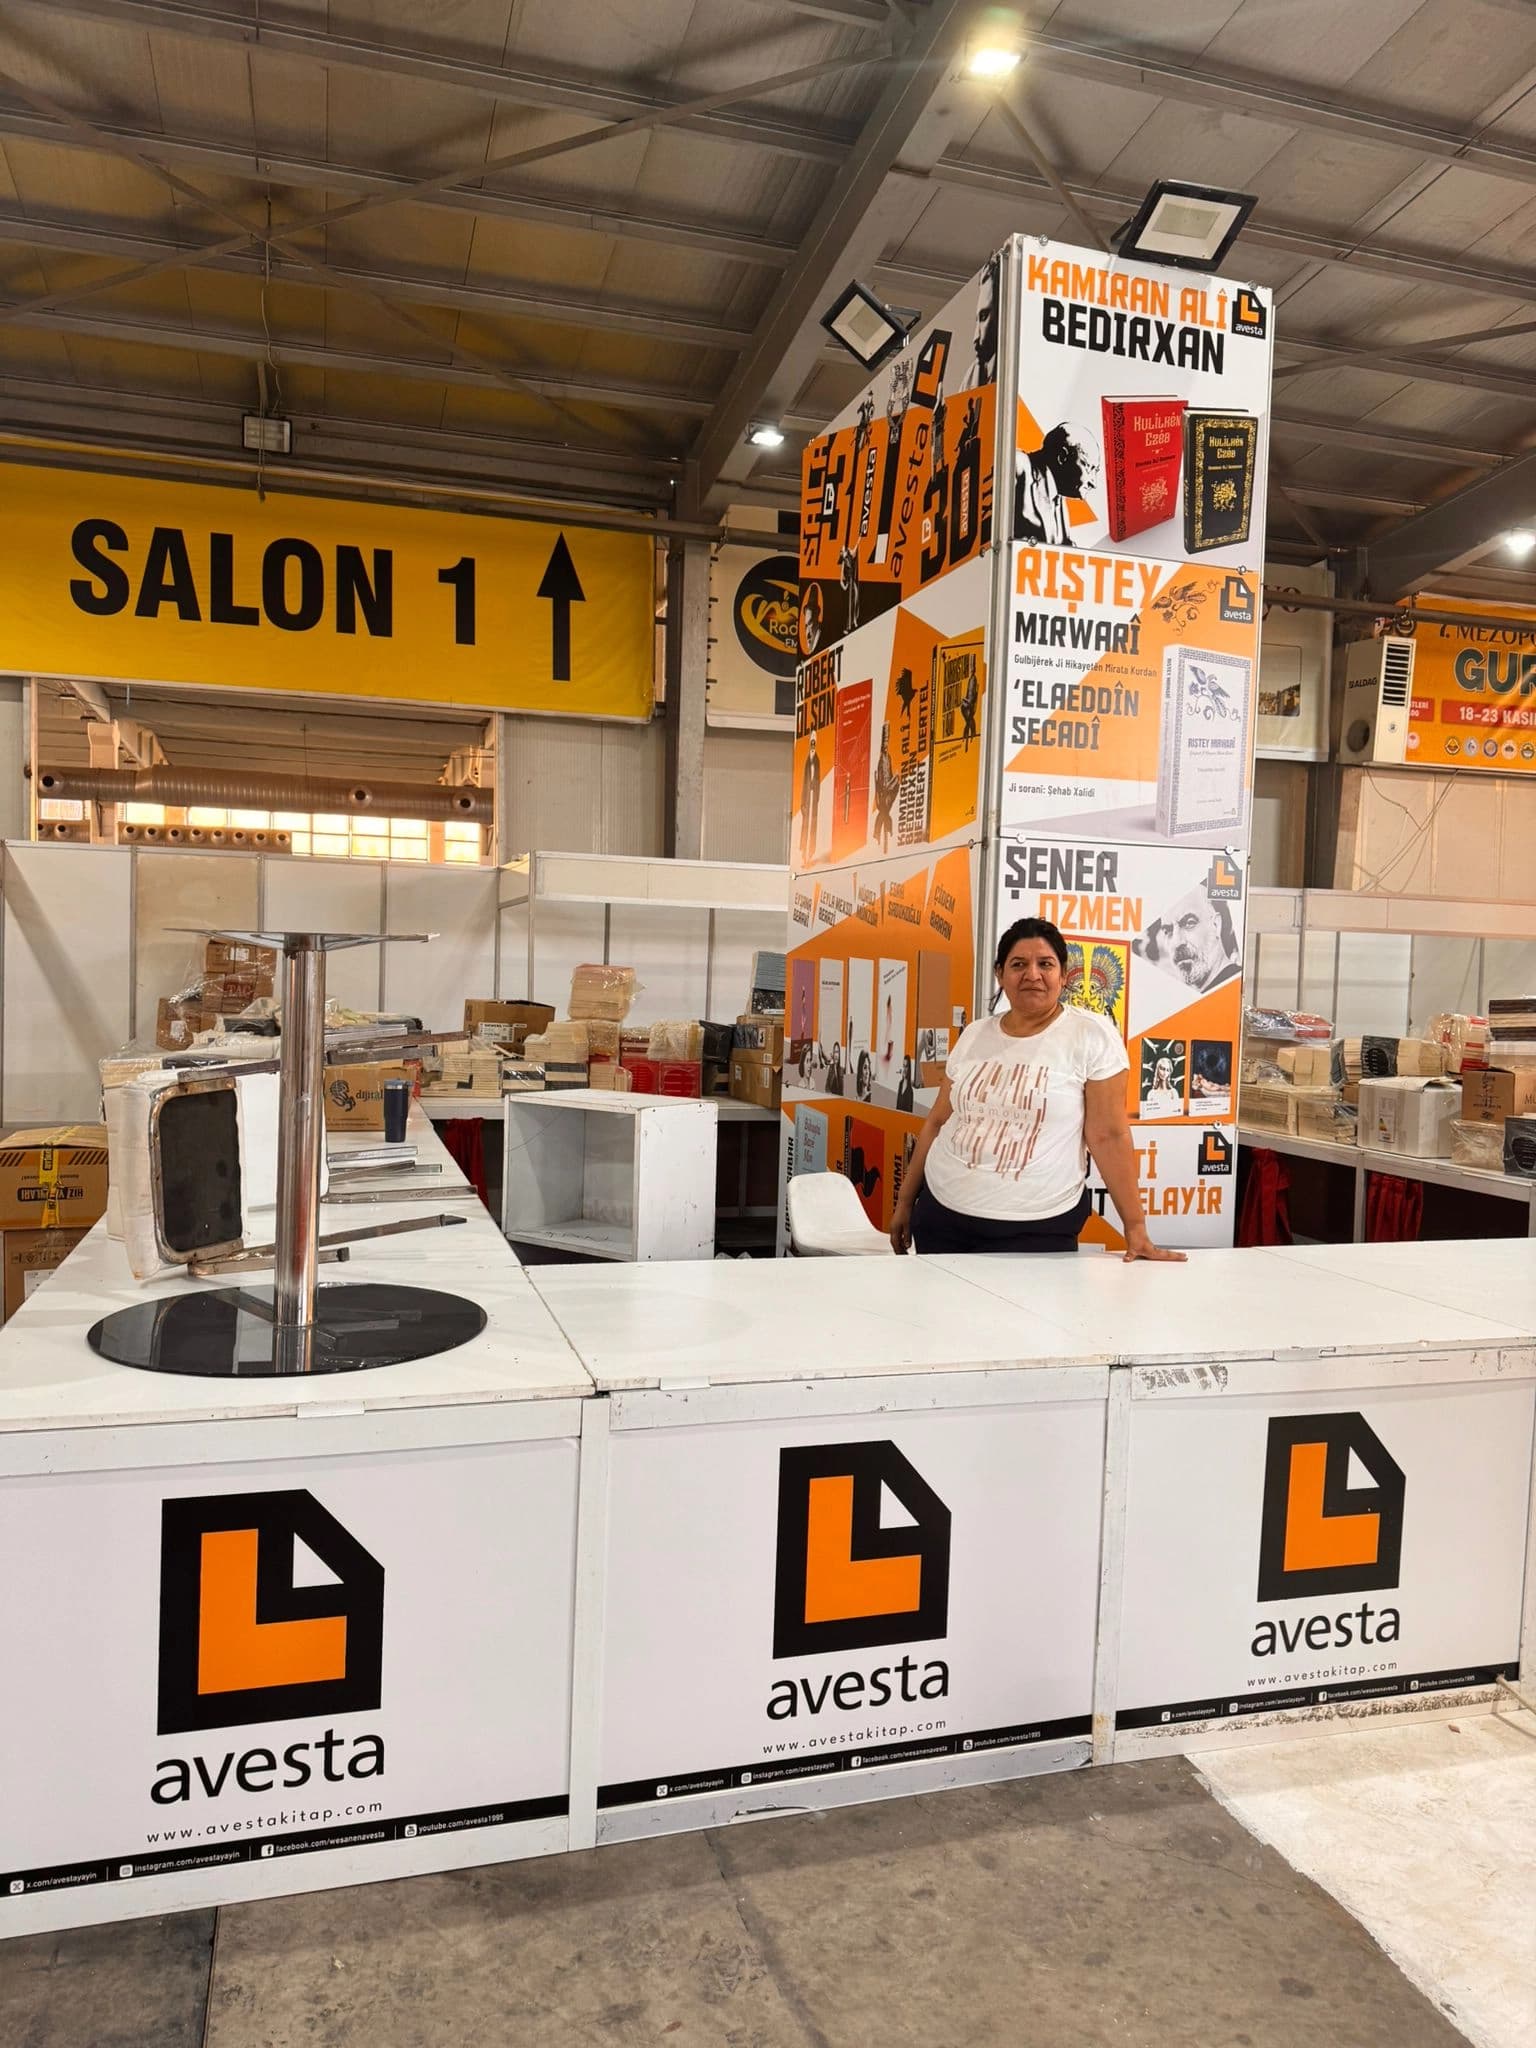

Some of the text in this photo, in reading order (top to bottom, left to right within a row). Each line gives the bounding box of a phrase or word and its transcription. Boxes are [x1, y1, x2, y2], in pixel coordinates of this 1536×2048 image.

[1028, 254, 1169, 318] KAMIRAN
[1043, 298, 1225, 374] BEDIRXAN
[1235, 323, 1264, 336] avesta
[860, 447, 877, 537] avesta
[891, 422, 929, 578] avesta
[960, 473, 969, 537] avesta
[70, 518, 476, 645] SALON 1
[1015, 611, 1141, 655] MIRWARÎ
[1223, 609, 1252, 621] avesta
[796, 646, 844, 704] ROBERT
[796, 688, 835, 739] OLSON
[1011, 715, 1101, 752] SECADÎ
[1459, 706, 1498, 723] 18-23
[1004, 846, 1118, 899] ŞENER
[1211, 887, 1239, 898] avesta
[1202, 1162, 1229, 1172] avesta
[1251, 1602, 1400, 1657] avesta
[766, 1655, 949, 1720] avesta
[763, 1719, 946, 1754] www.avestakitap.com
[150, 1728, 385, 1804] avesta
[146, 1801, 383, 1843] www.avestakitap.com
